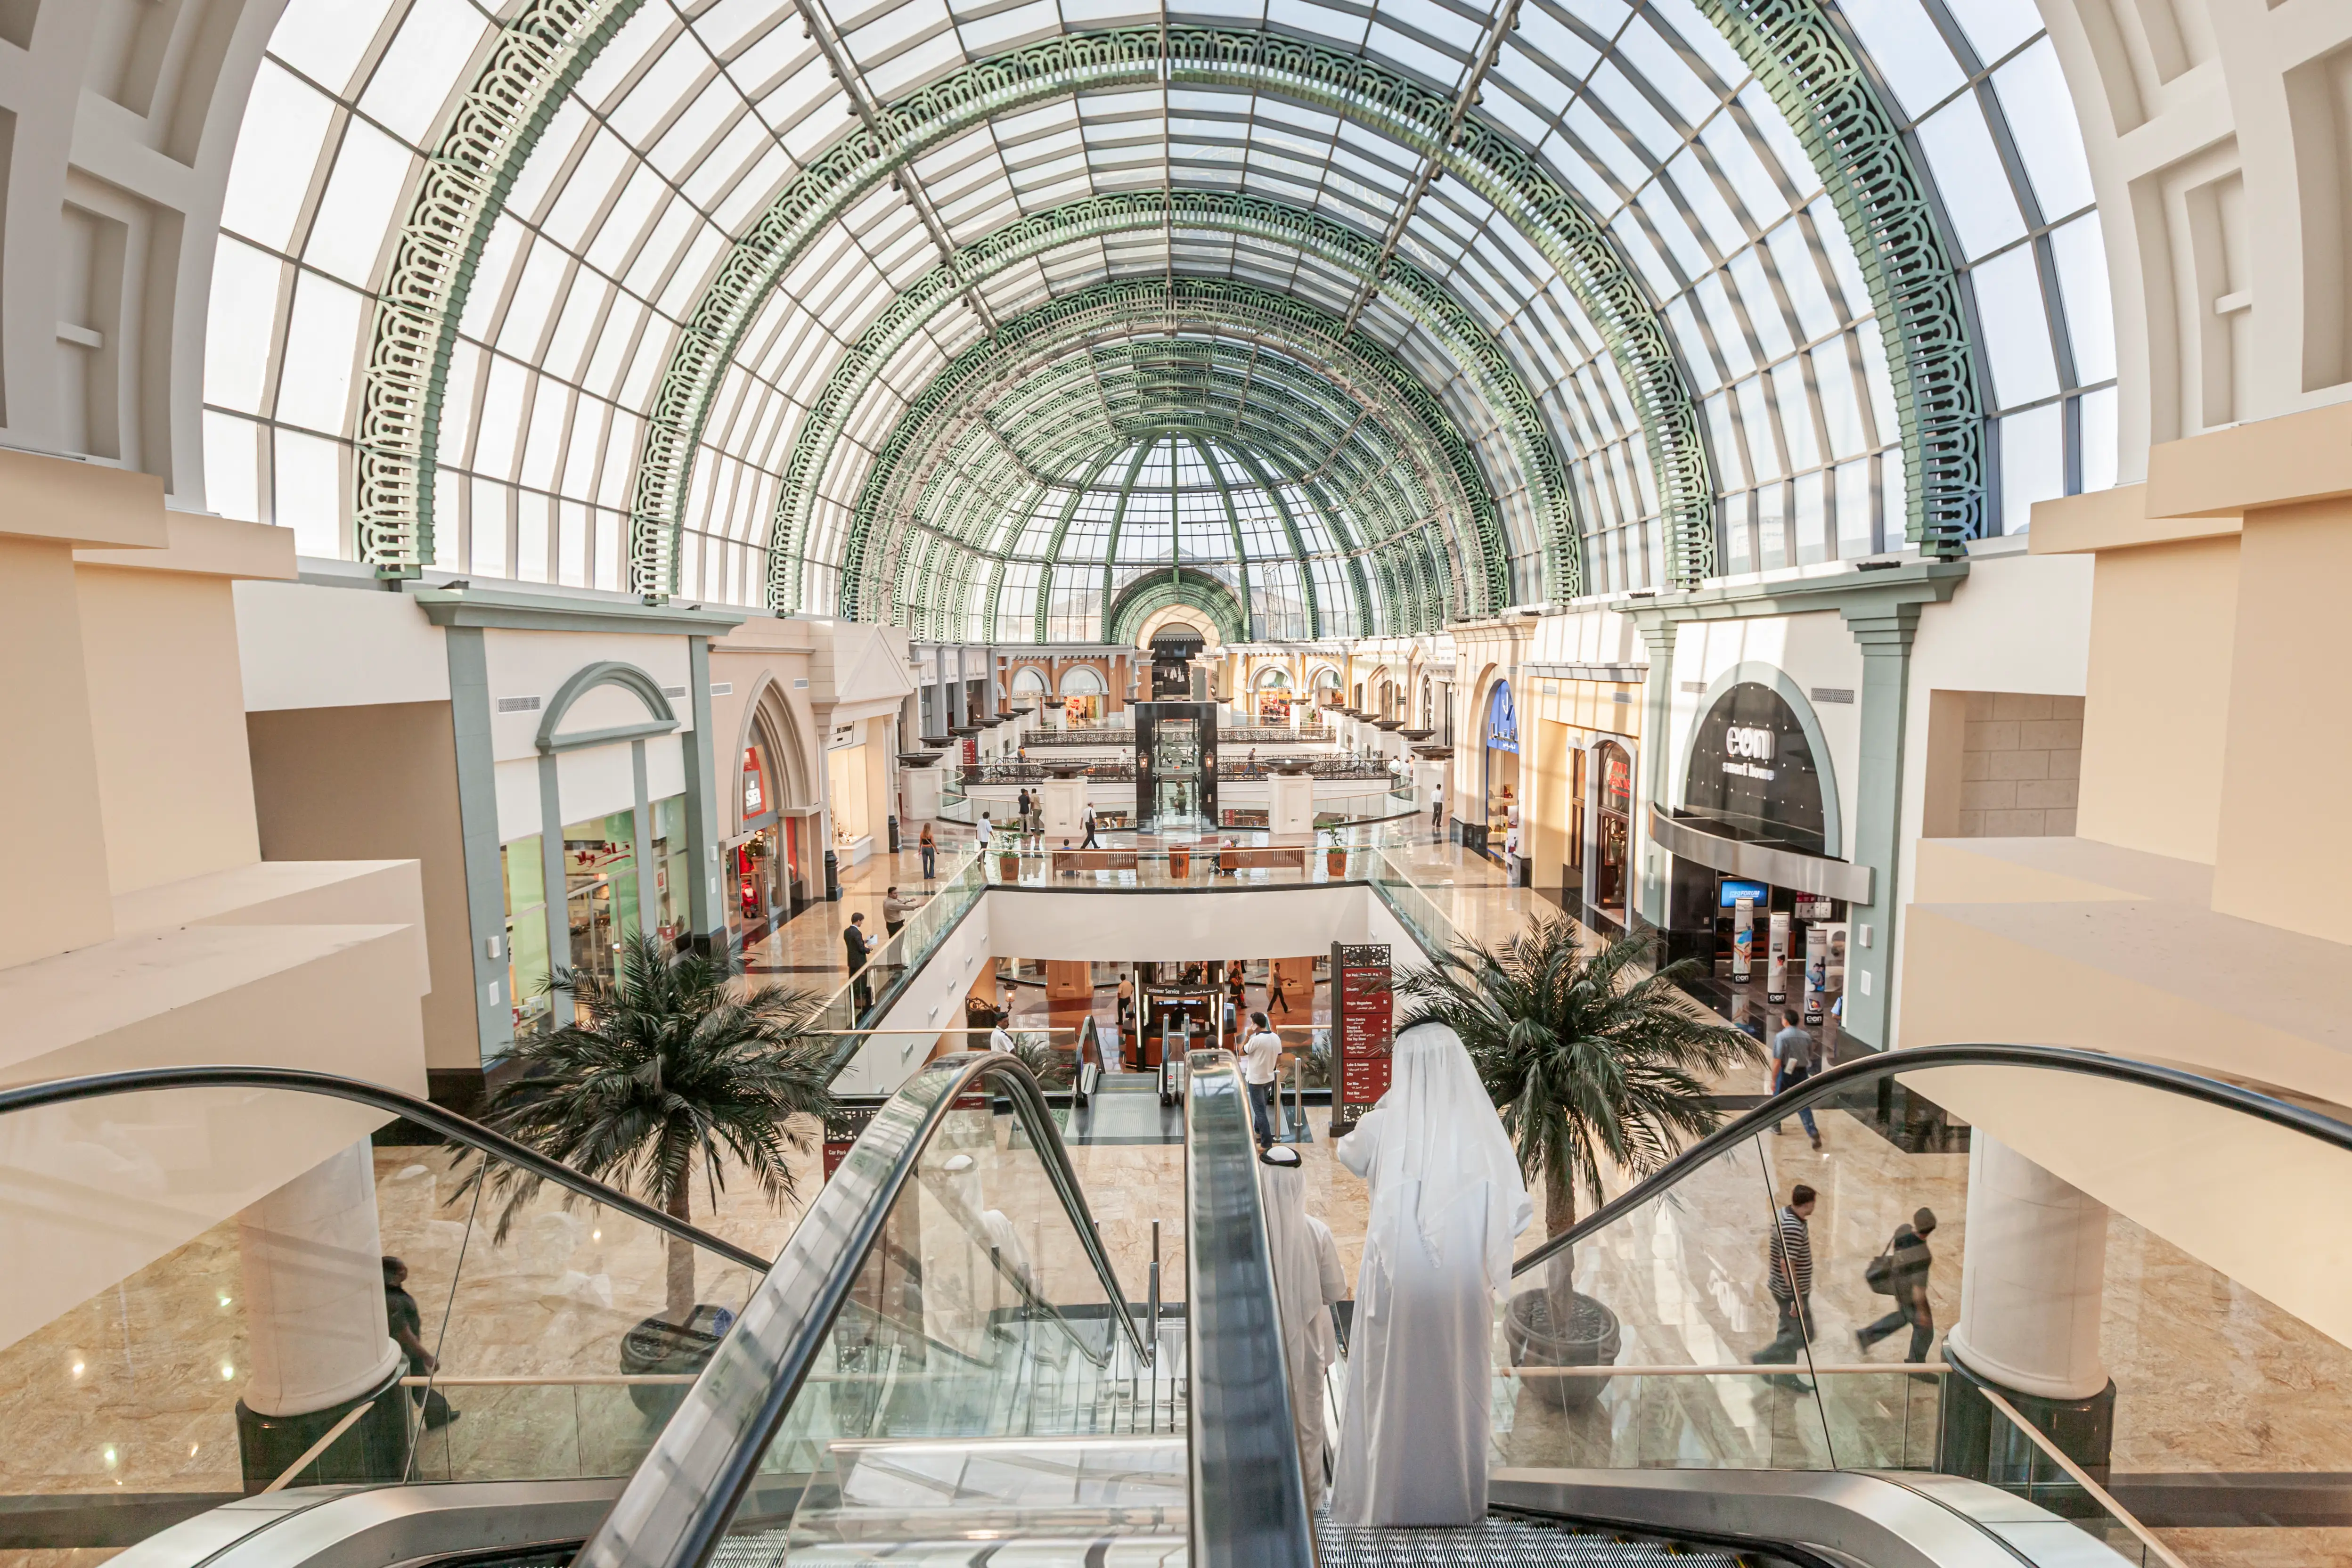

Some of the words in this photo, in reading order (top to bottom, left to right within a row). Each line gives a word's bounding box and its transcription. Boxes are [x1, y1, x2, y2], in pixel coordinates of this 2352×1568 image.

[1726, 727, 1772, 760] eon
[1722, 762, 1748, 776] smart
[1748, 763, 1775, 781] home
